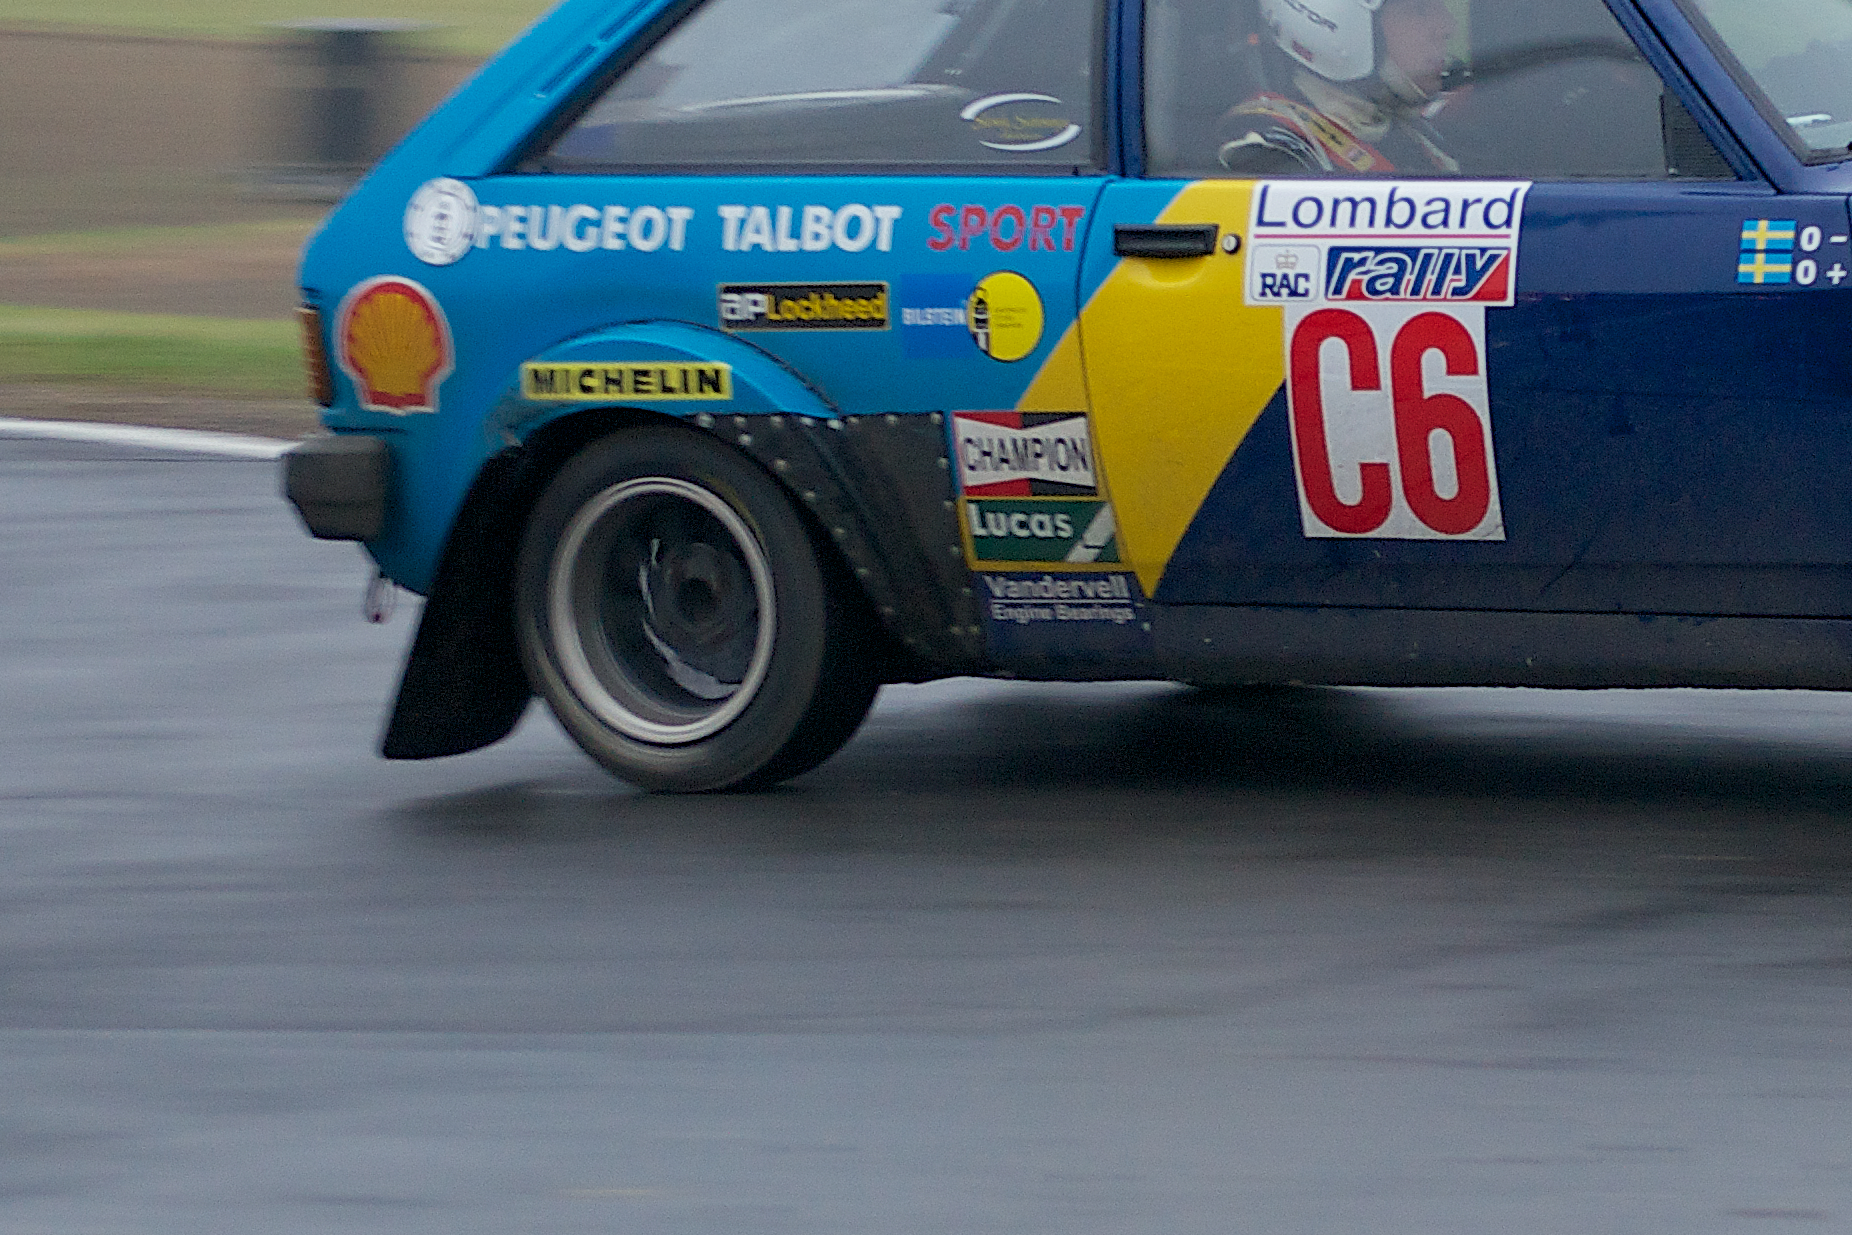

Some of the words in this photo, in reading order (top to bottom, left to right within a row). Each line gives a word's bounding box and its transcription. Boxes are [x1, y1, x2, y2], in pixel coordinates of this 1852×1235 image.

[1256, 185, 1523, 230] Lombard
[475, 203, 695, 252] PEUGEOT
[717, 203, 903, 252] TALBOT
[926, 203, 1086, 252] SPORT
[1258, 272, 1311, 298] RAC
[1328, 248, 1508, 300] rally
[767, 291, 886, 321] Lockheed
[532, 368, 722, 395] MICHELIN
[1289, 307, 1491, 536] C6
[963, 436, 1090, 472] CHAMPION
[966, 501, 1074, 539] Lucas
[982, 574, 1132, 598] Vandervell
[990, 603, 1054, 624] Engine
